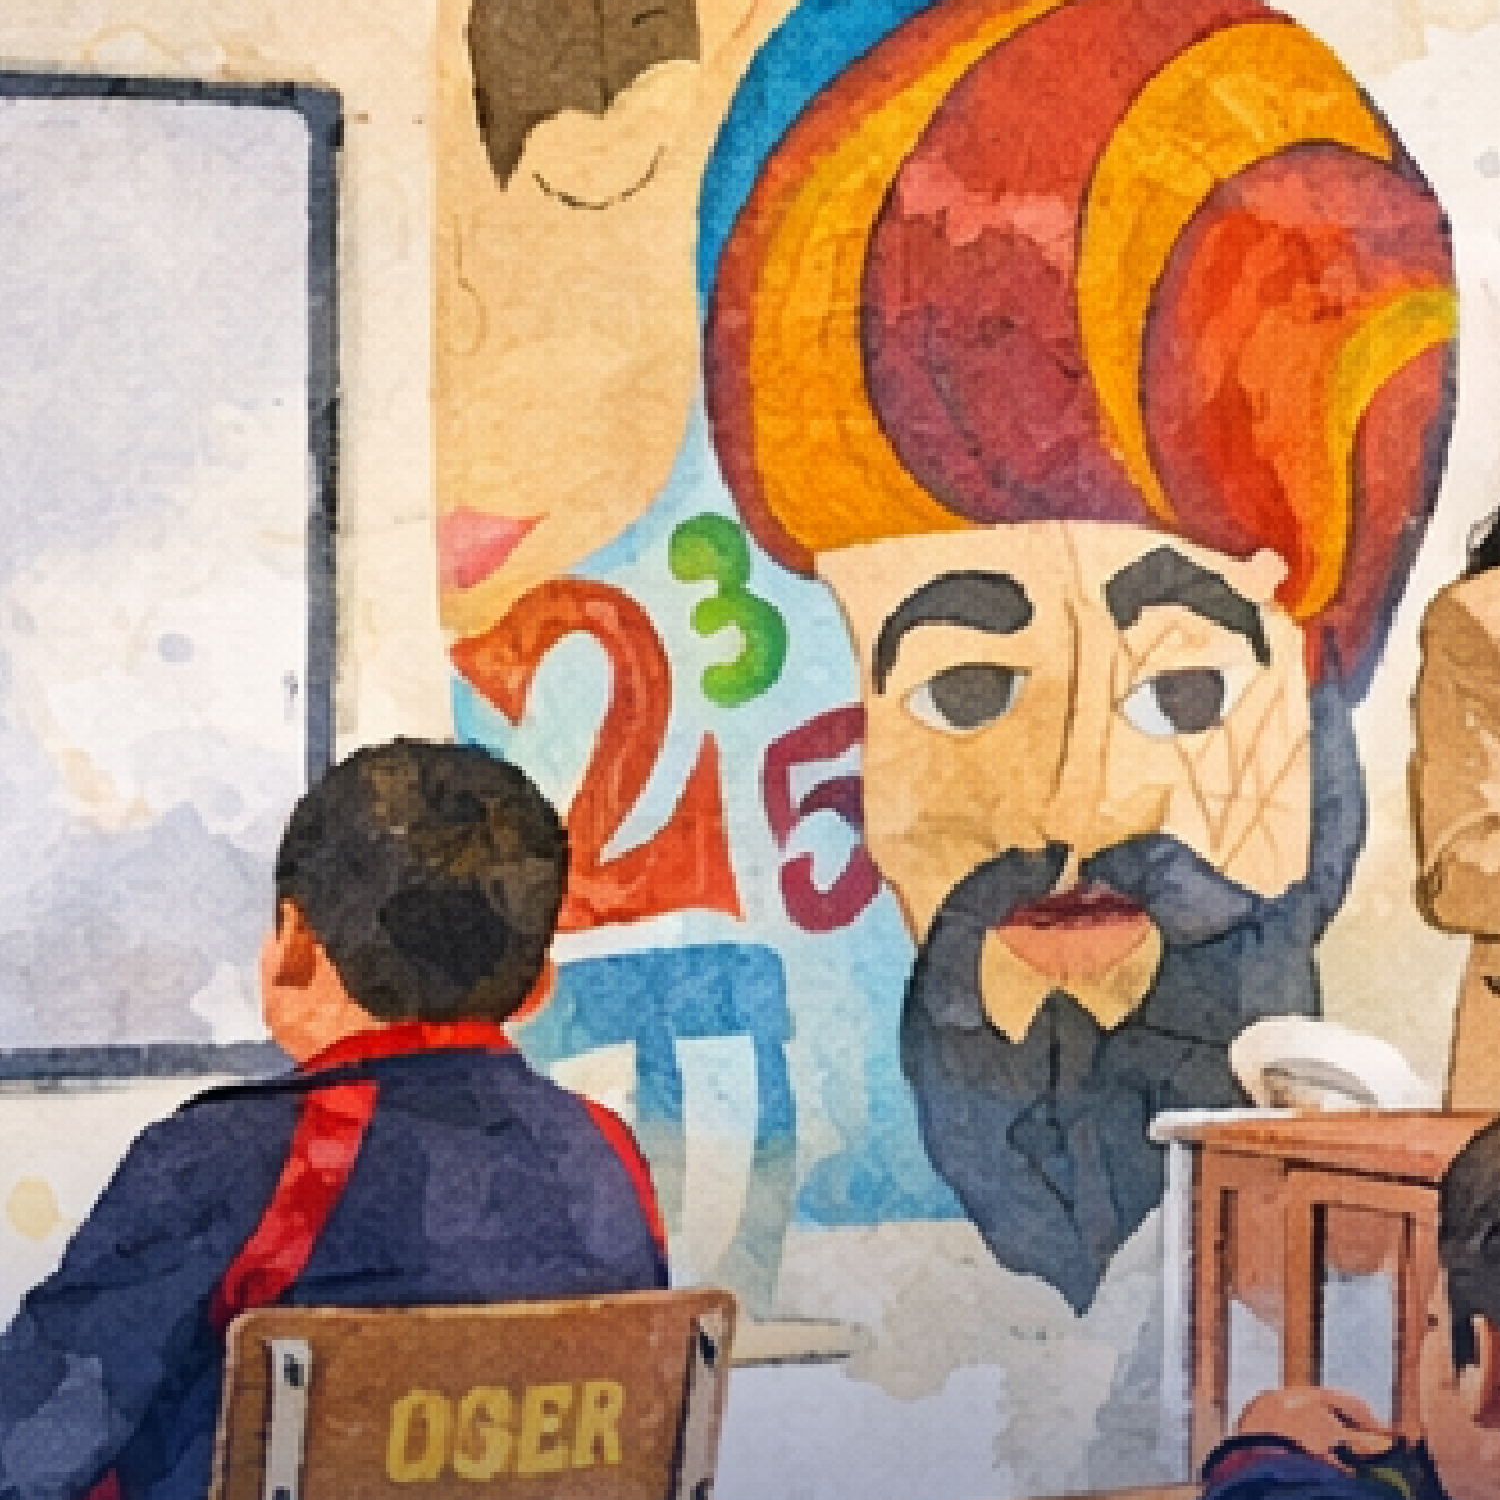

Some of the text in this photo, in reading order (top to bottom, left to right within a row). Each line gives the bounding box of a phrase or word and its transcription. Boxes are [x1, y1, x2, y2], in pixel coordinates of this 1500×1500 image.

[667, 512, 789, 709] 3
[450, 574, 745, 932] 2
[761, 700, 882, 933] 5
